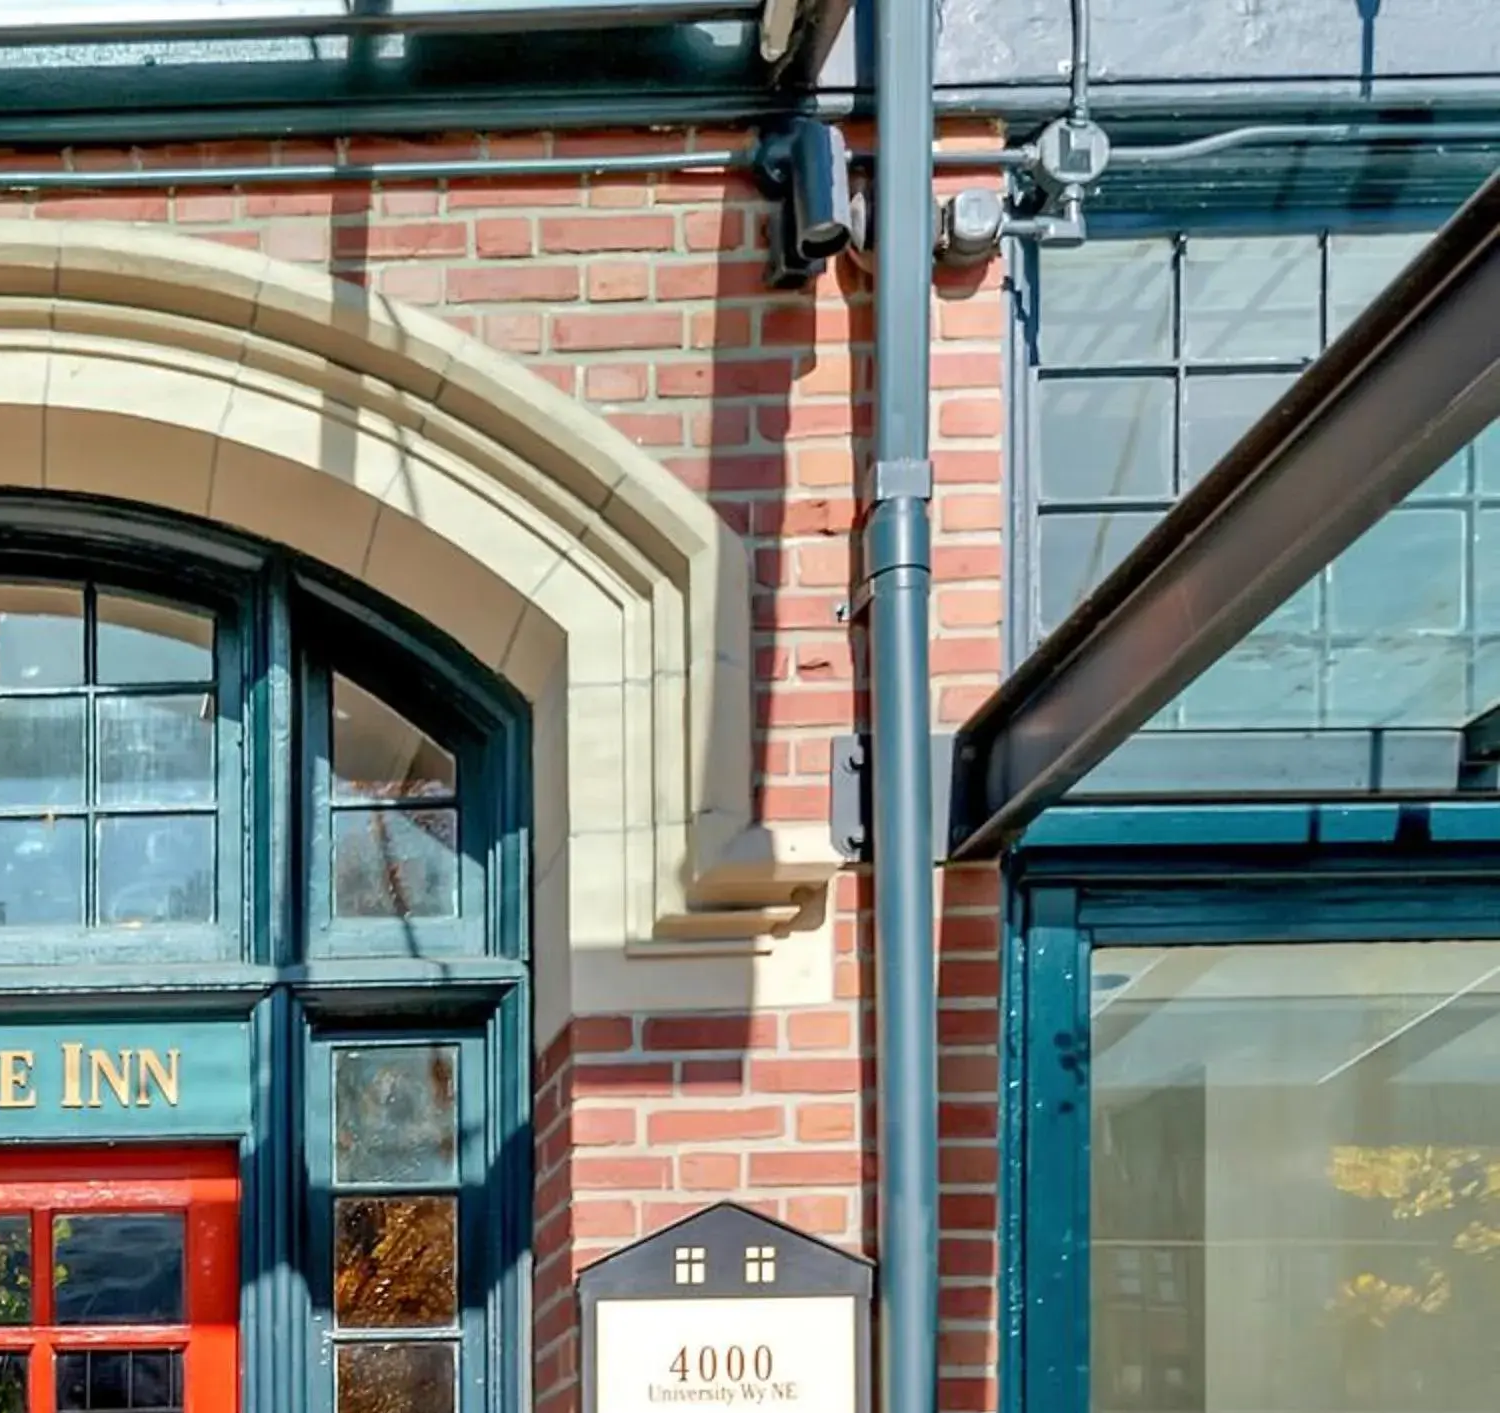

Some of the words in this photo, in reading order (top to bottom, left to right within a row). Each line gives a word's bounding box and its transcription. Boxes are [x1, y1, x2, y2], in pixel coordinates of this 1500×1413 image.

[60, 1041, 182, 1109] INN
[669, 1344, 775, 1383] 4000
[648, 1382, 735, 1405] University
[740, 1383, 765, 1405] Wy
[771, 1382, 798, 1401] NE
